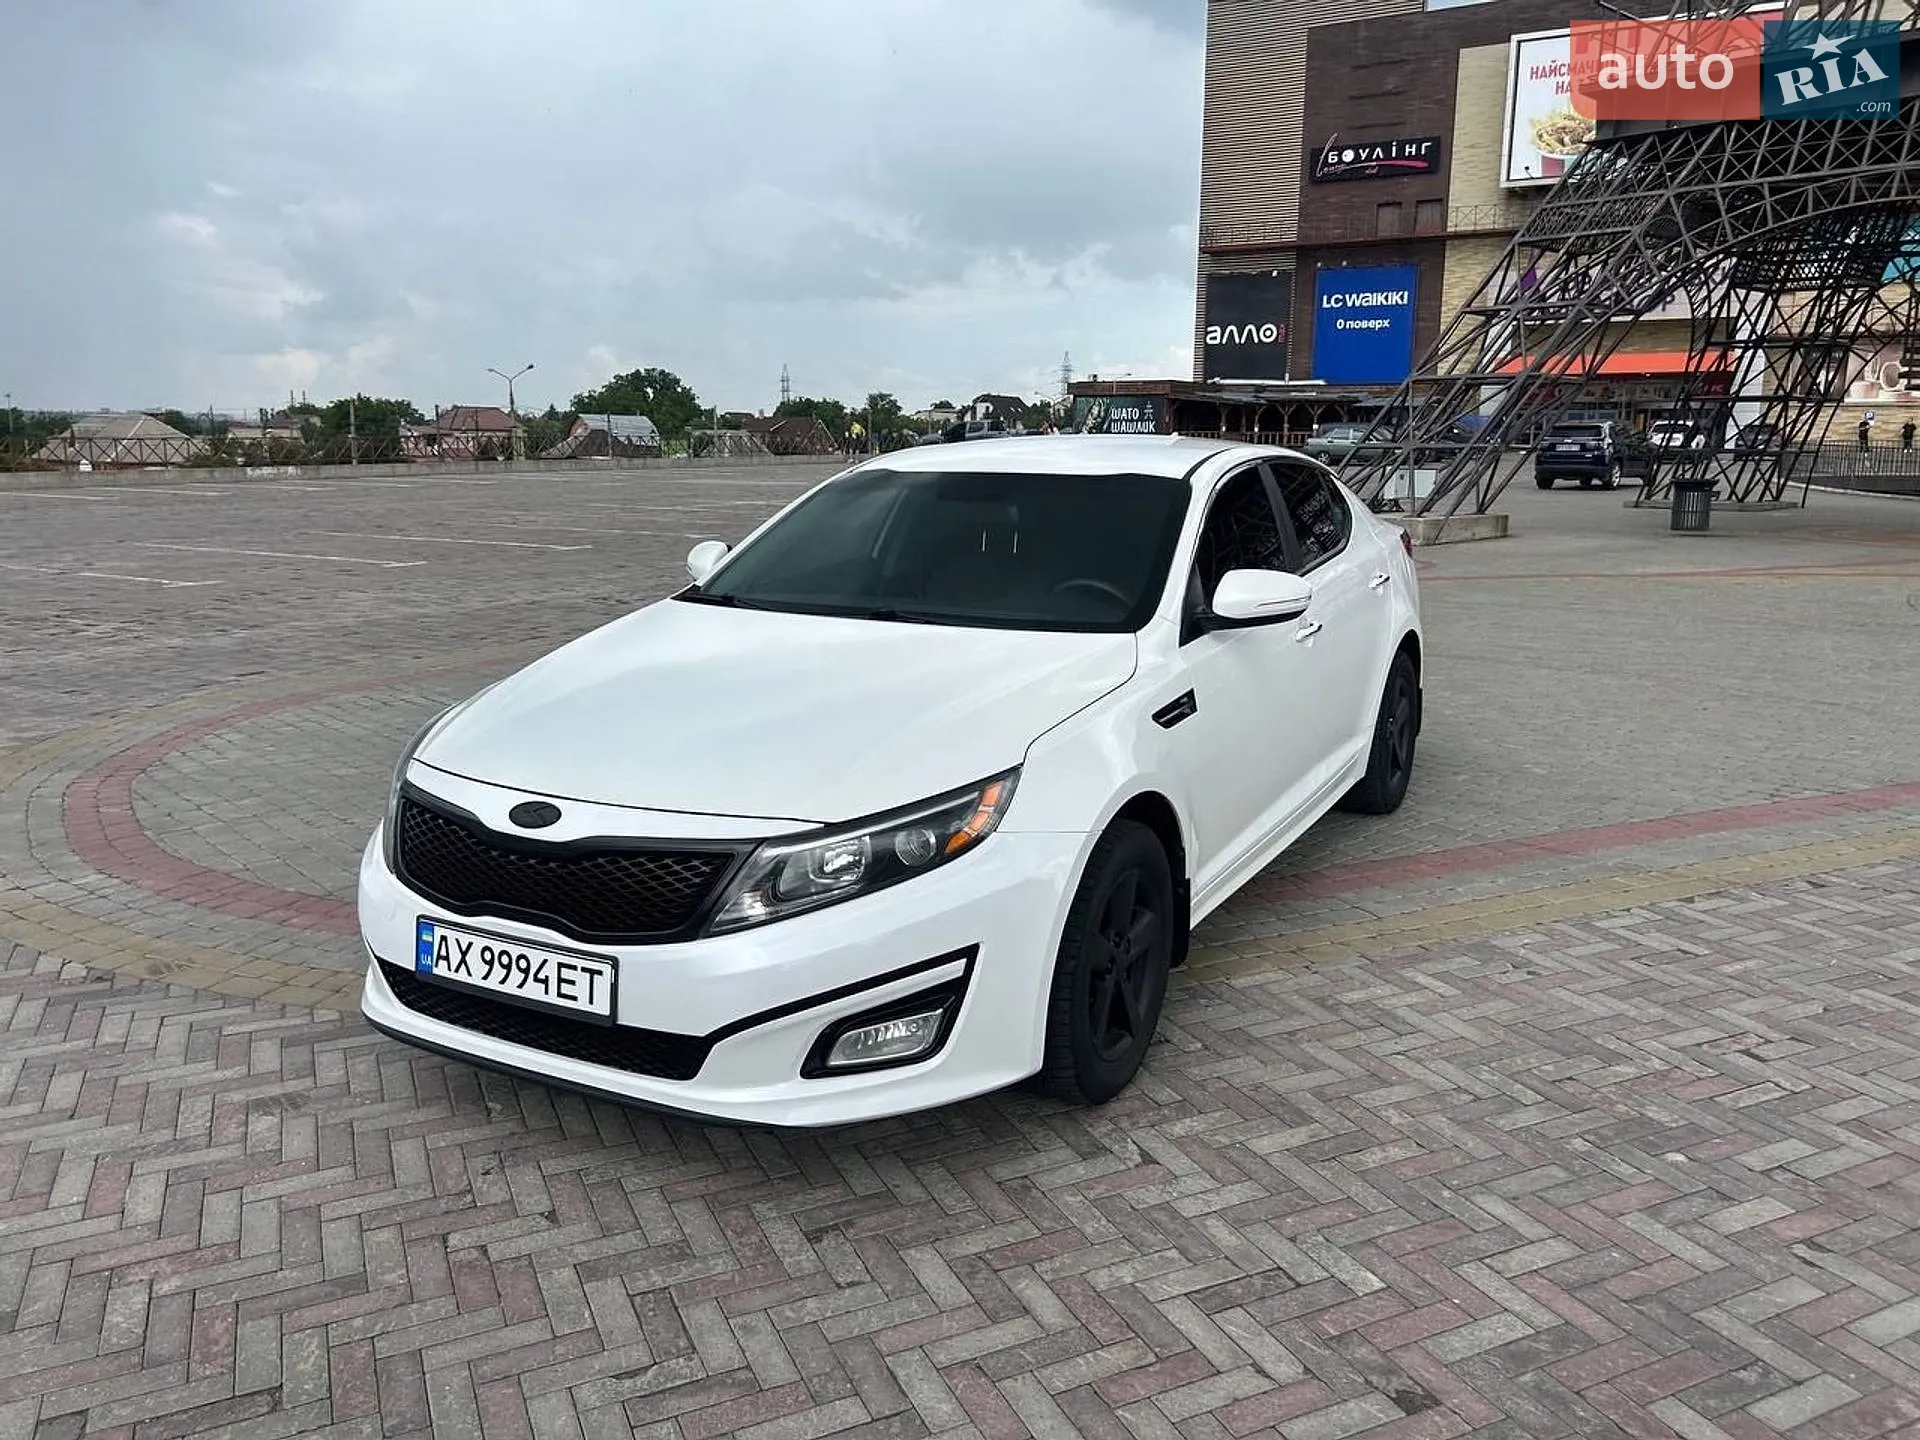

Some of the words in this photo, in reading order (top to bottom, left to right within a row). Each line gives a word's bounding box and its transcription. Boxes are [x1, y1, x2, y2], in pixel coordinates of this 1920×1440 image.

[1327, 141, 1432, 163] БОУЛІНГ
[1322, 293, 1344, 308] LC
[1346, 318, 1390, 330] поверх
[1111, 408, 1139, 419] ШАТО
[1111, 421, 1156, 433] ШАШЛИК
[420, 953, 432, 966] UA
[435, 935, 473, 977] AX
[480, 945, 549, 995] 9994
[556, 962, 603, 1005] ET
